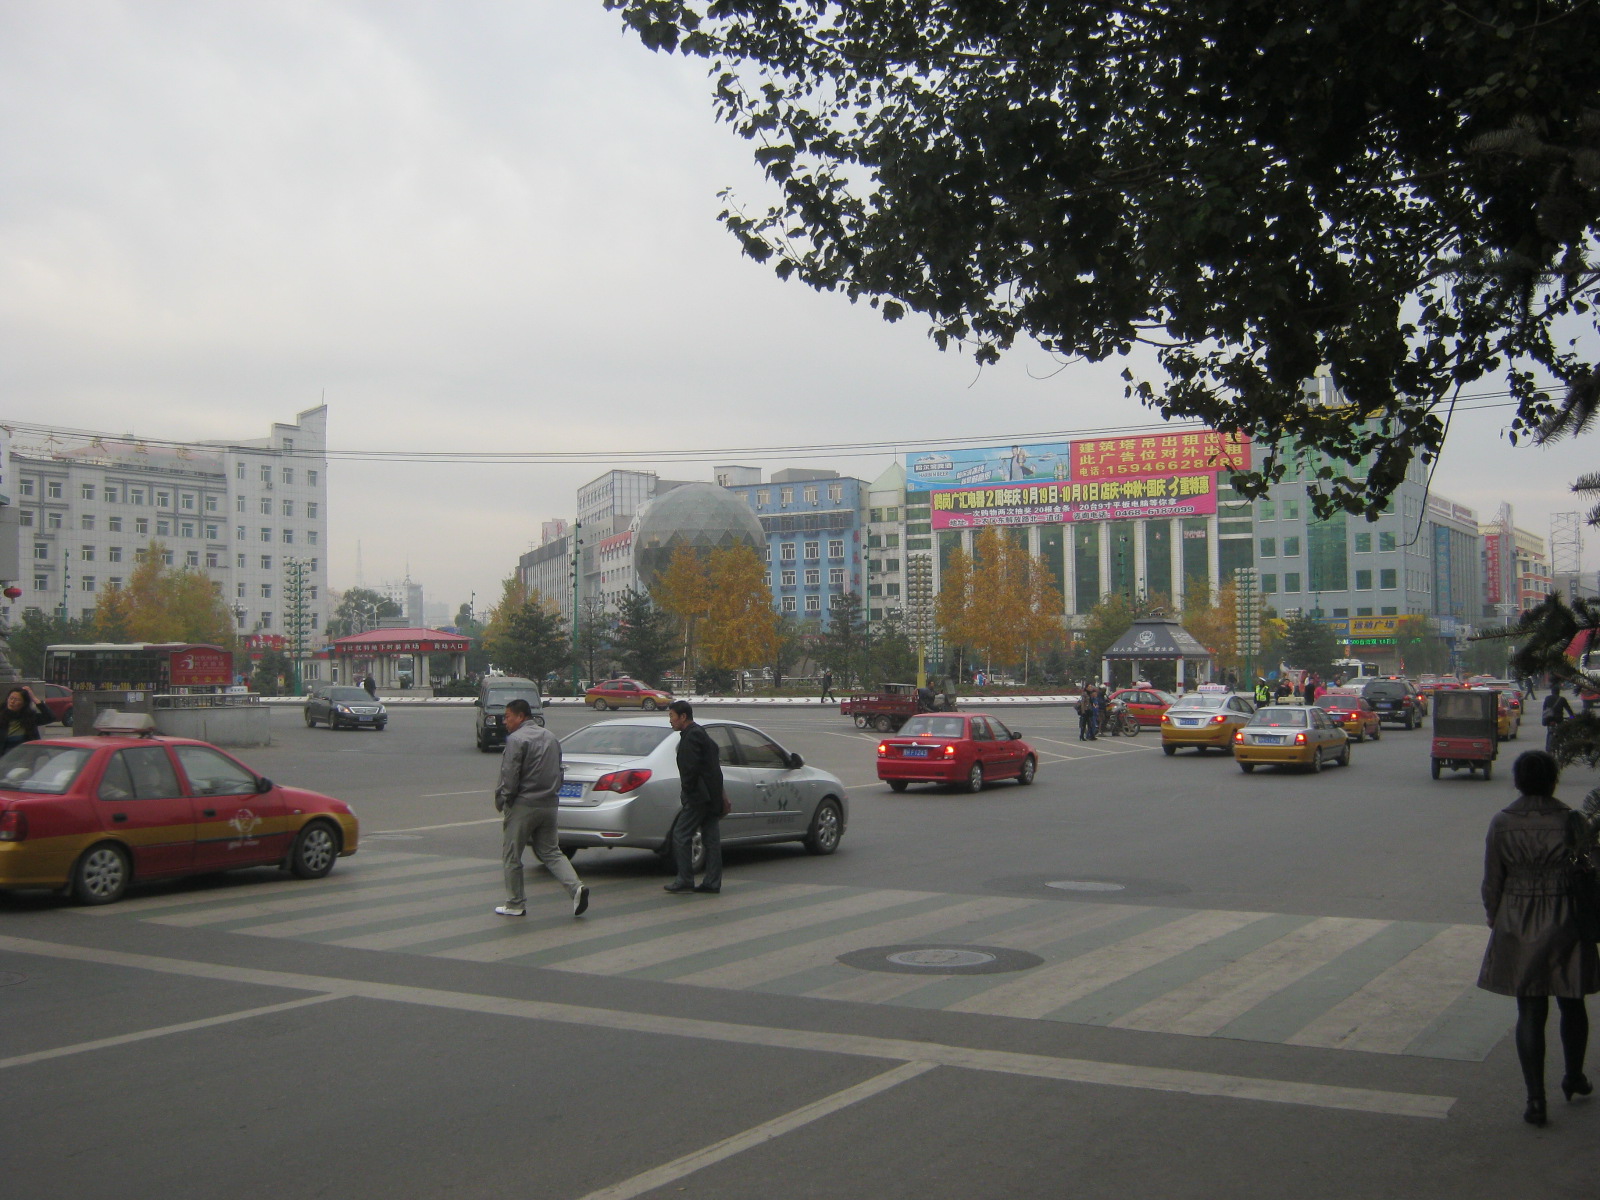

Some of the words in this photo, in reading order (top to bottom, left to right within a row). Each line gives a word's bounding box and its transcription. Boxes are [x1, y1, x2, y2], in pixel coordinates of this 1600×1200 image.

[1079, 444, 1243, 466] 此广告位对外出租
